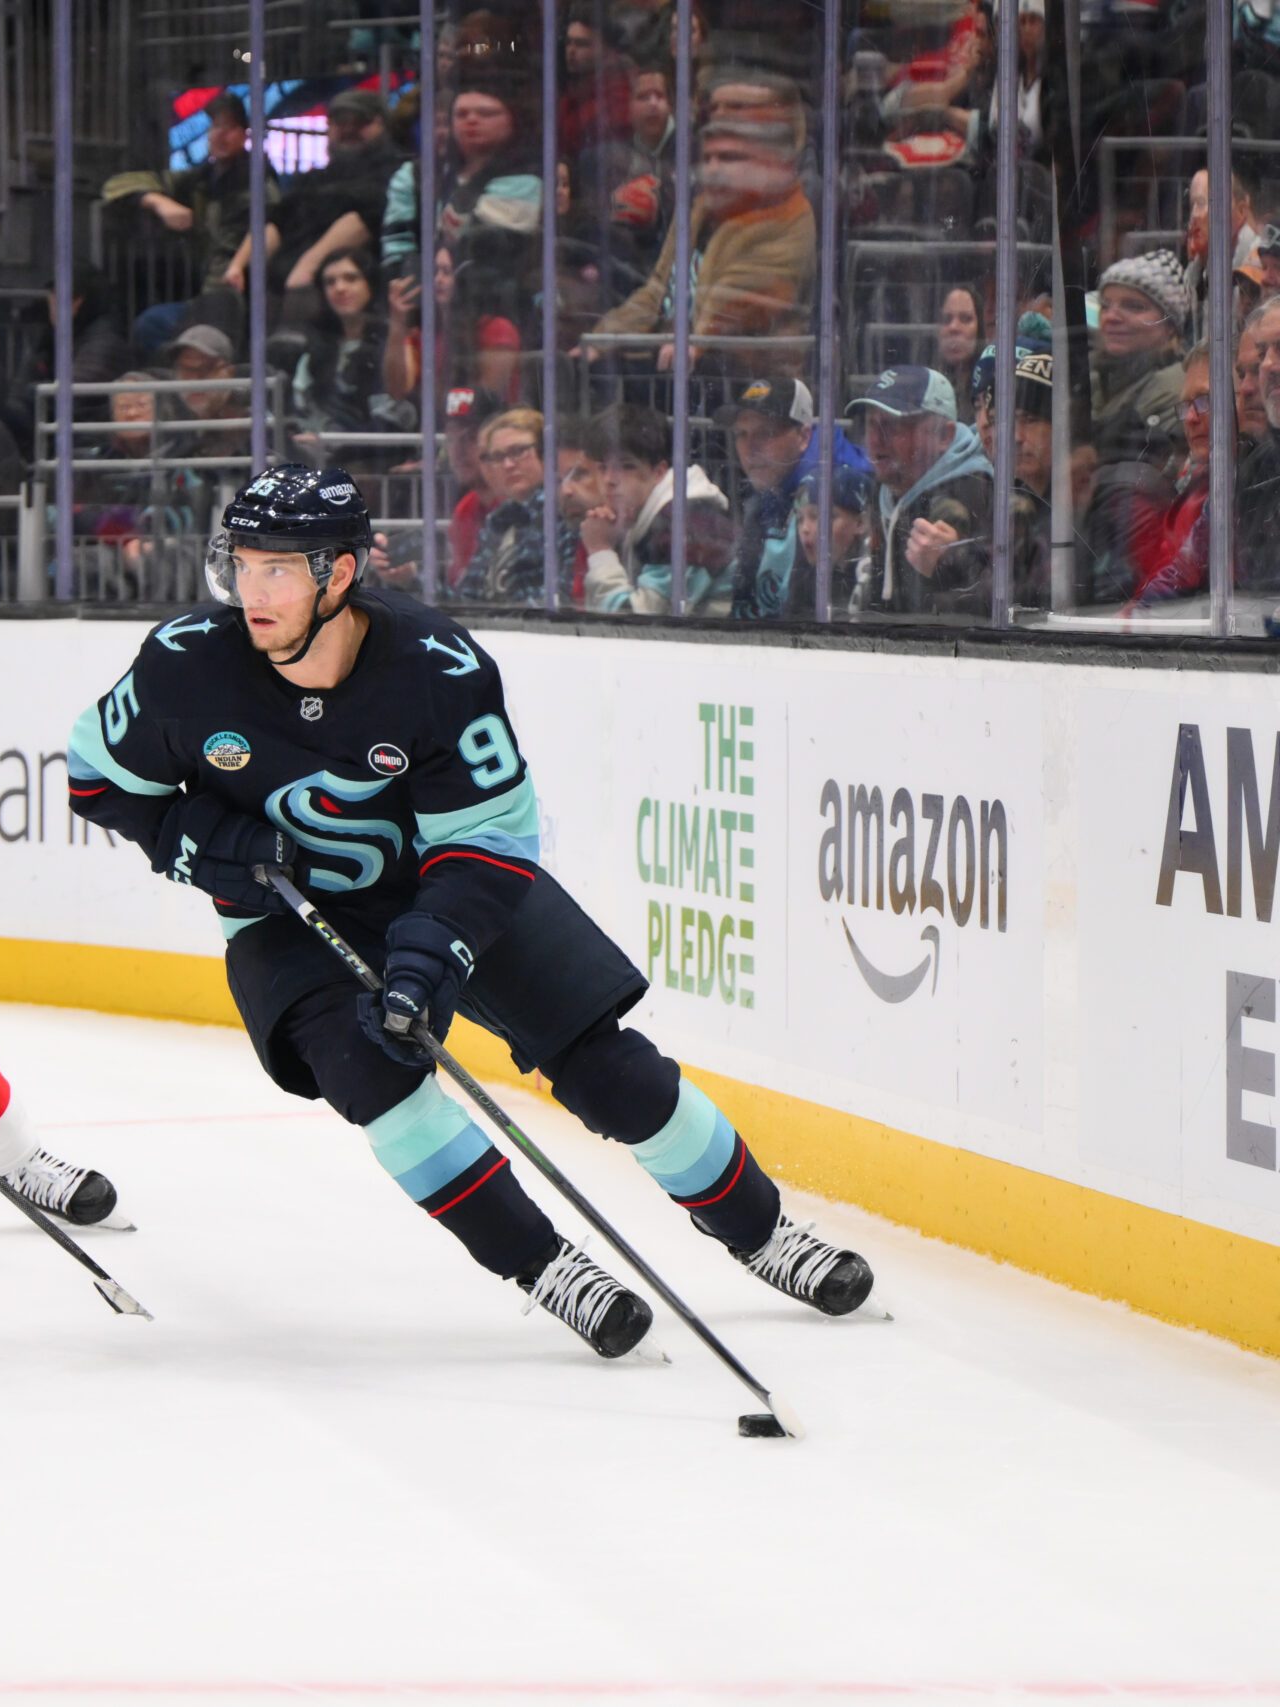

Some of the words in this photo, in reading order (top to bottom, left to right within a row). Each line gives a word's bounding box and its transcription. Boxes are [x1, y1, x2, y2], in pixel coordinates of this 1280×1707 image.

[231, 516, 260, 528] CCM
[374, 753, 402, 766] BONDO
[457, 713, 520, 790] 9
[699, 702, 754, 797] THE
[636, 796, 754, 903] CLIMATE
[818, 779, 1008, 934] amazon
[647, 898, 754, 1010] PLEDGE
[388, 991, 419, 1012] CCM
